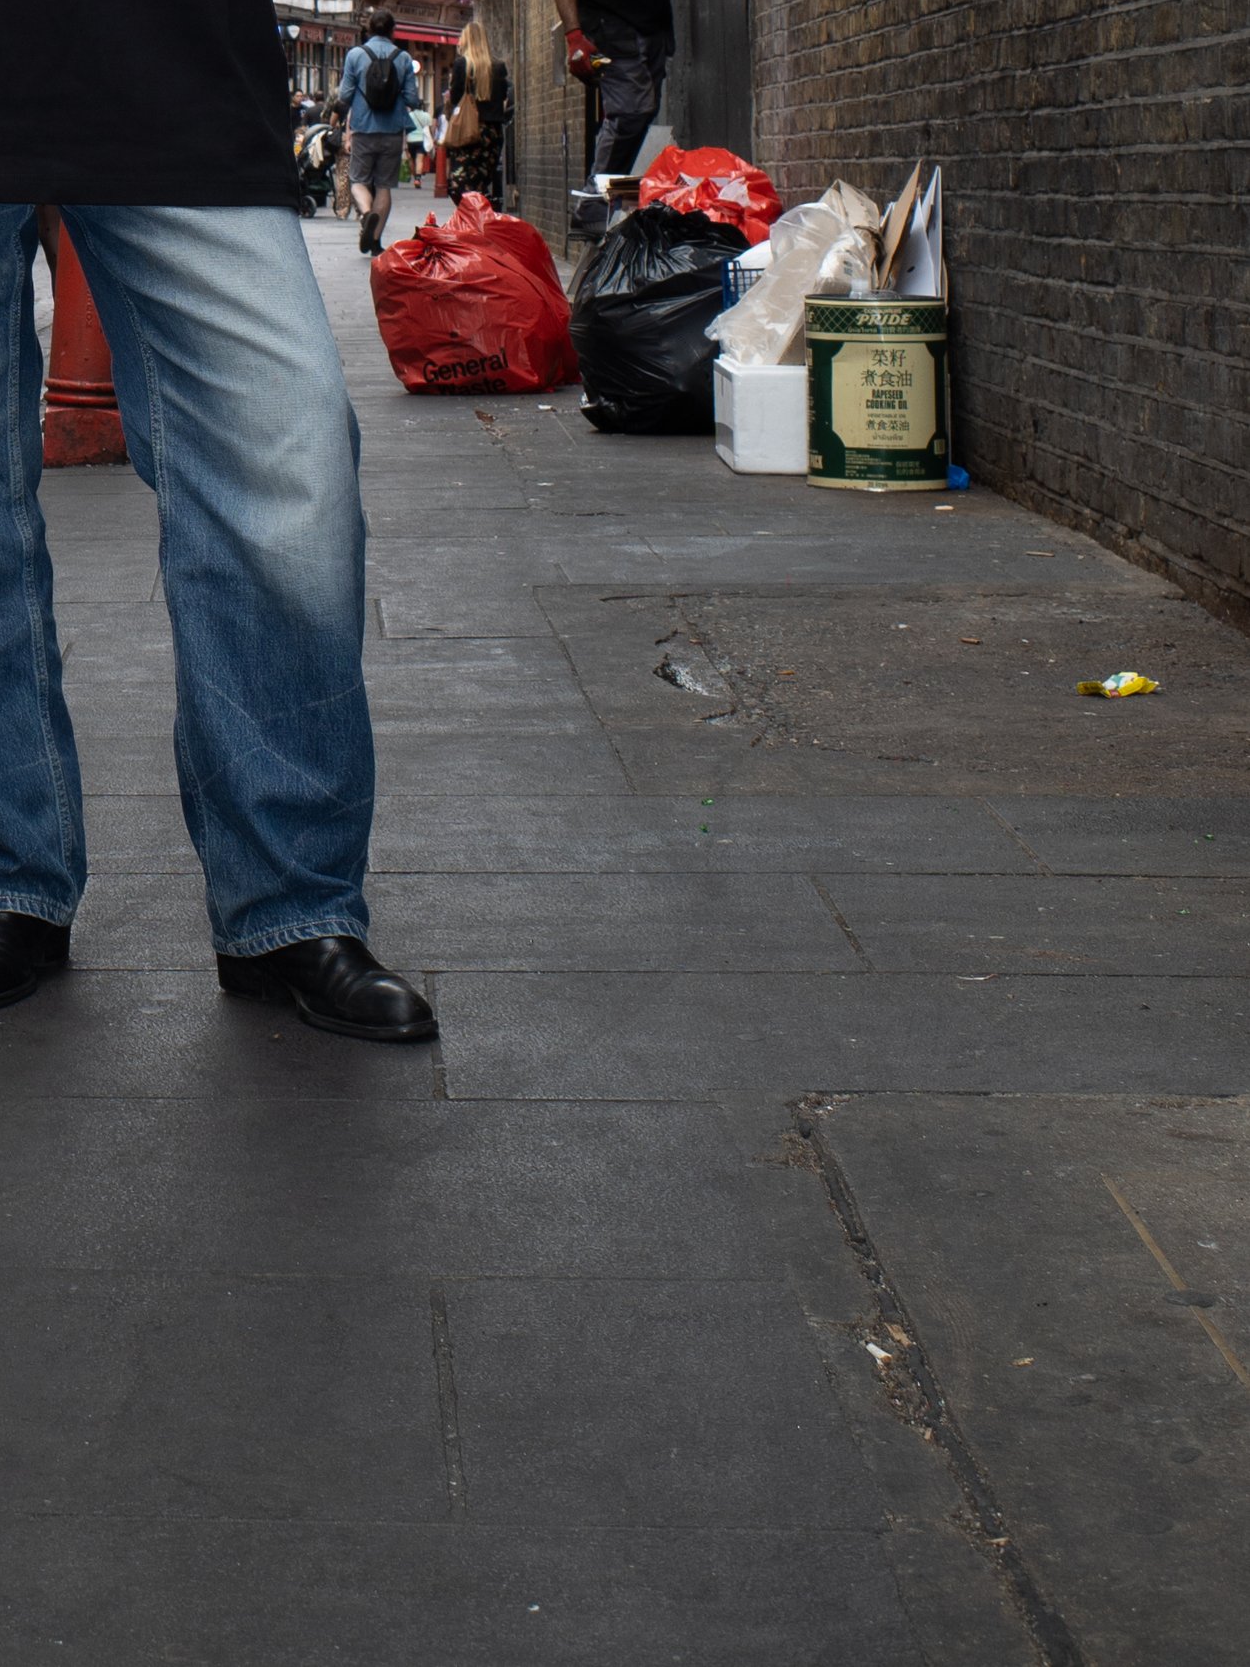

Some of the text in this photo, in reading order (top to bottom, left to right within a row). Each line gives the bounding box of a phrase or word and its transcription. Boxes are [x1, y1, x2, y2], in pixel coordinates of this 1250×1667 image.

[855, 313, 913, 326] PRIDE
[871, 348, 906, 367] 菜籽
[422, 346, 510, 384] General
[860, 369, 913, 388] 煮食油
[871, 389, 904, 400] RAPESEED
[865, 399, 908, 410] COOKING OIL
[865, 419, 911, 432] 煮食菜油
